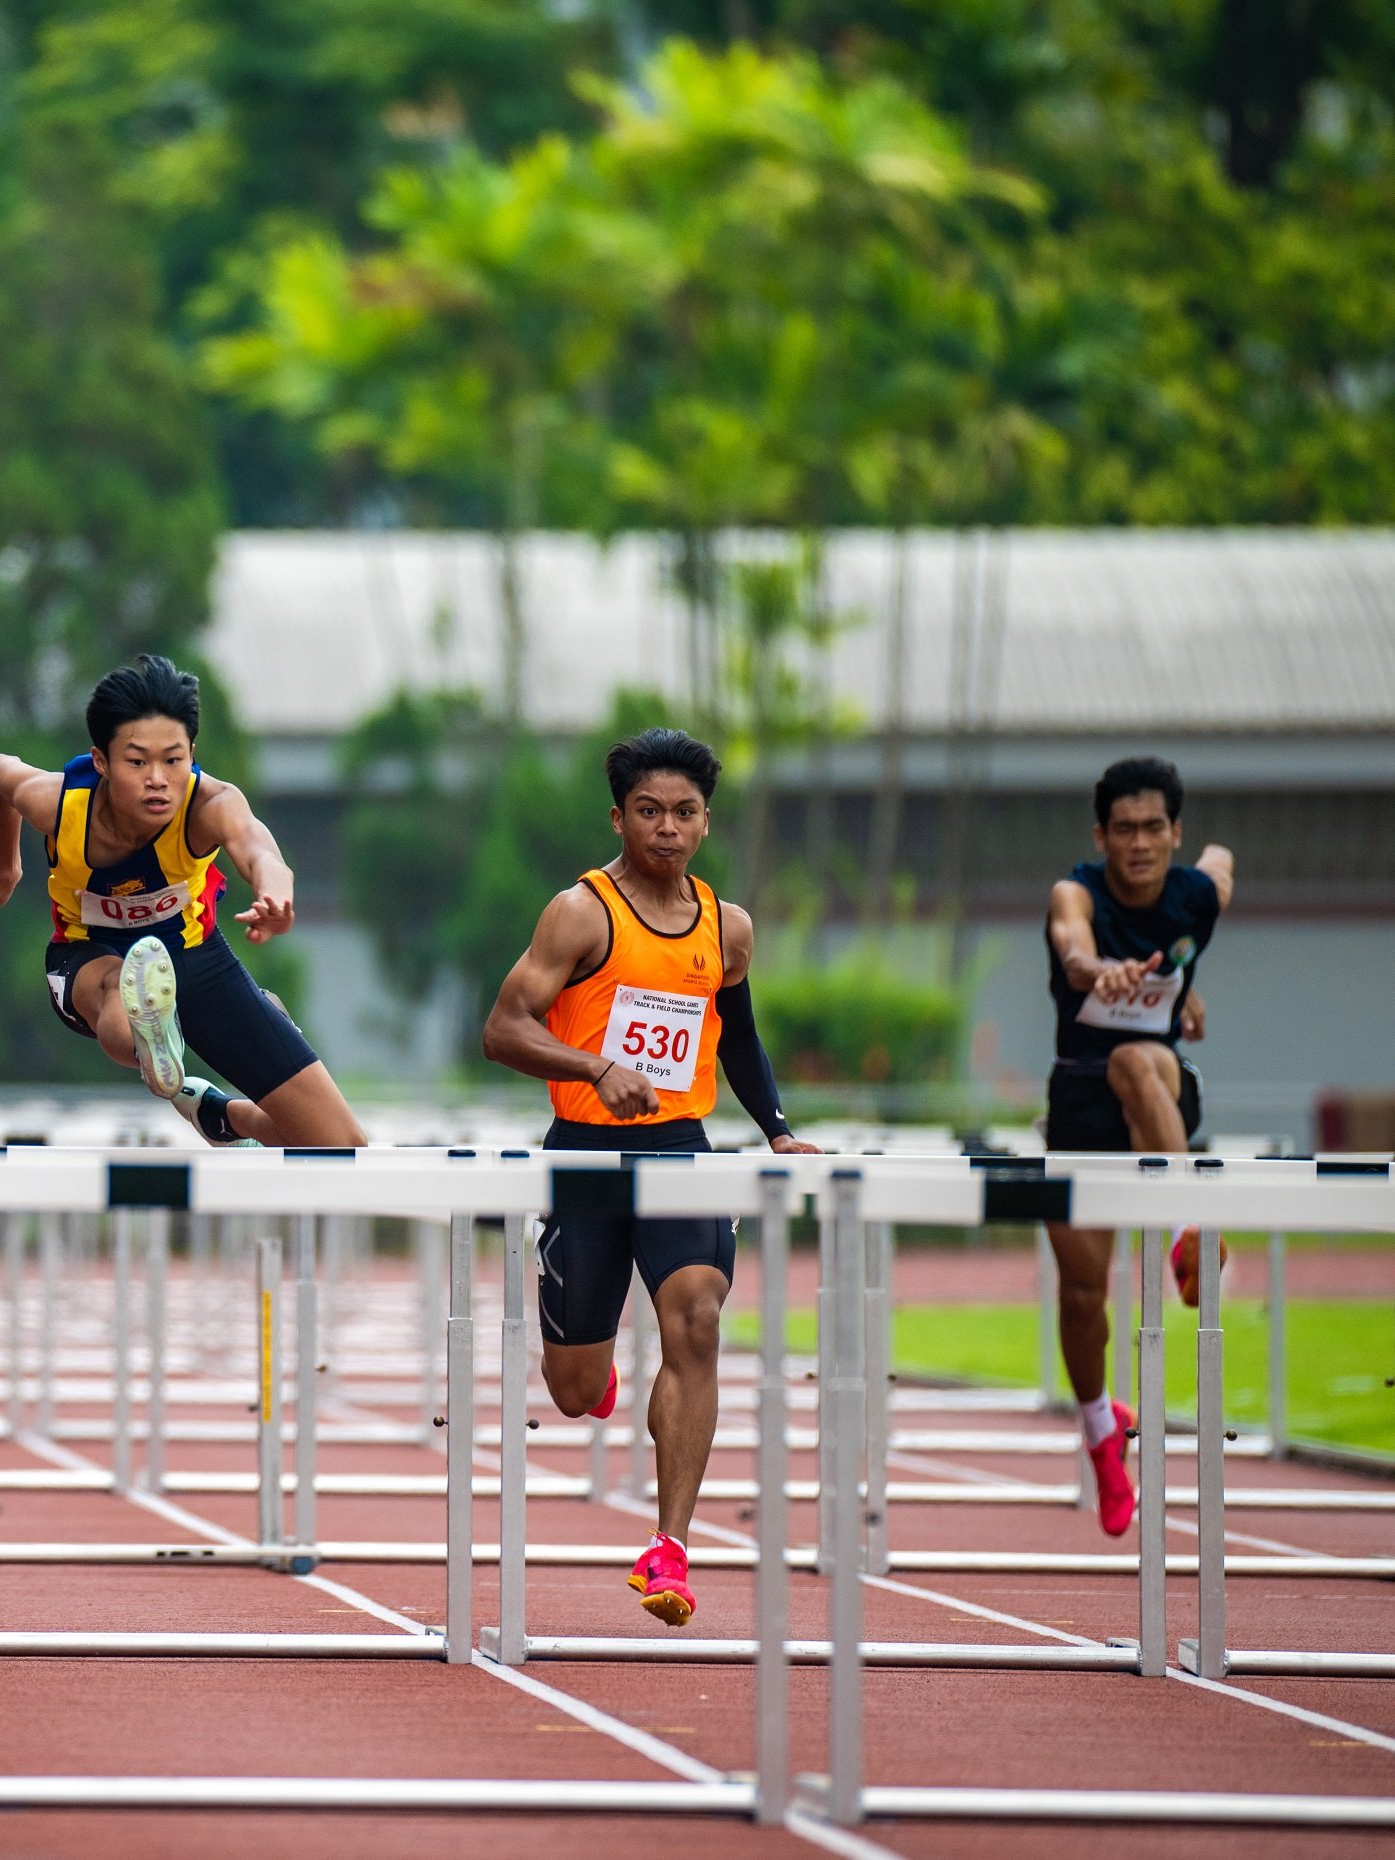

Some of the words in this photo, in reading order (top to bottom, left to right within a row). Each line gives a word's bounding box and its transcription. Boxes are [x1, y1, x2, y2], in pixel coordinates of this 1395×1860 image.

[102, 893, 178, 920] 086
[634, 1001, 650, 1009] TRACK
[656, 1004, 671, 1013] FIELD
[642, 994, 667, 1004] NATIONAL
[668, 998, 686, 1007] SCHOOL
[622, 1021, 689, 1063] 530
[635, 1061, 644, 1072] B
[646, 1064, 671, 1077] Boys
